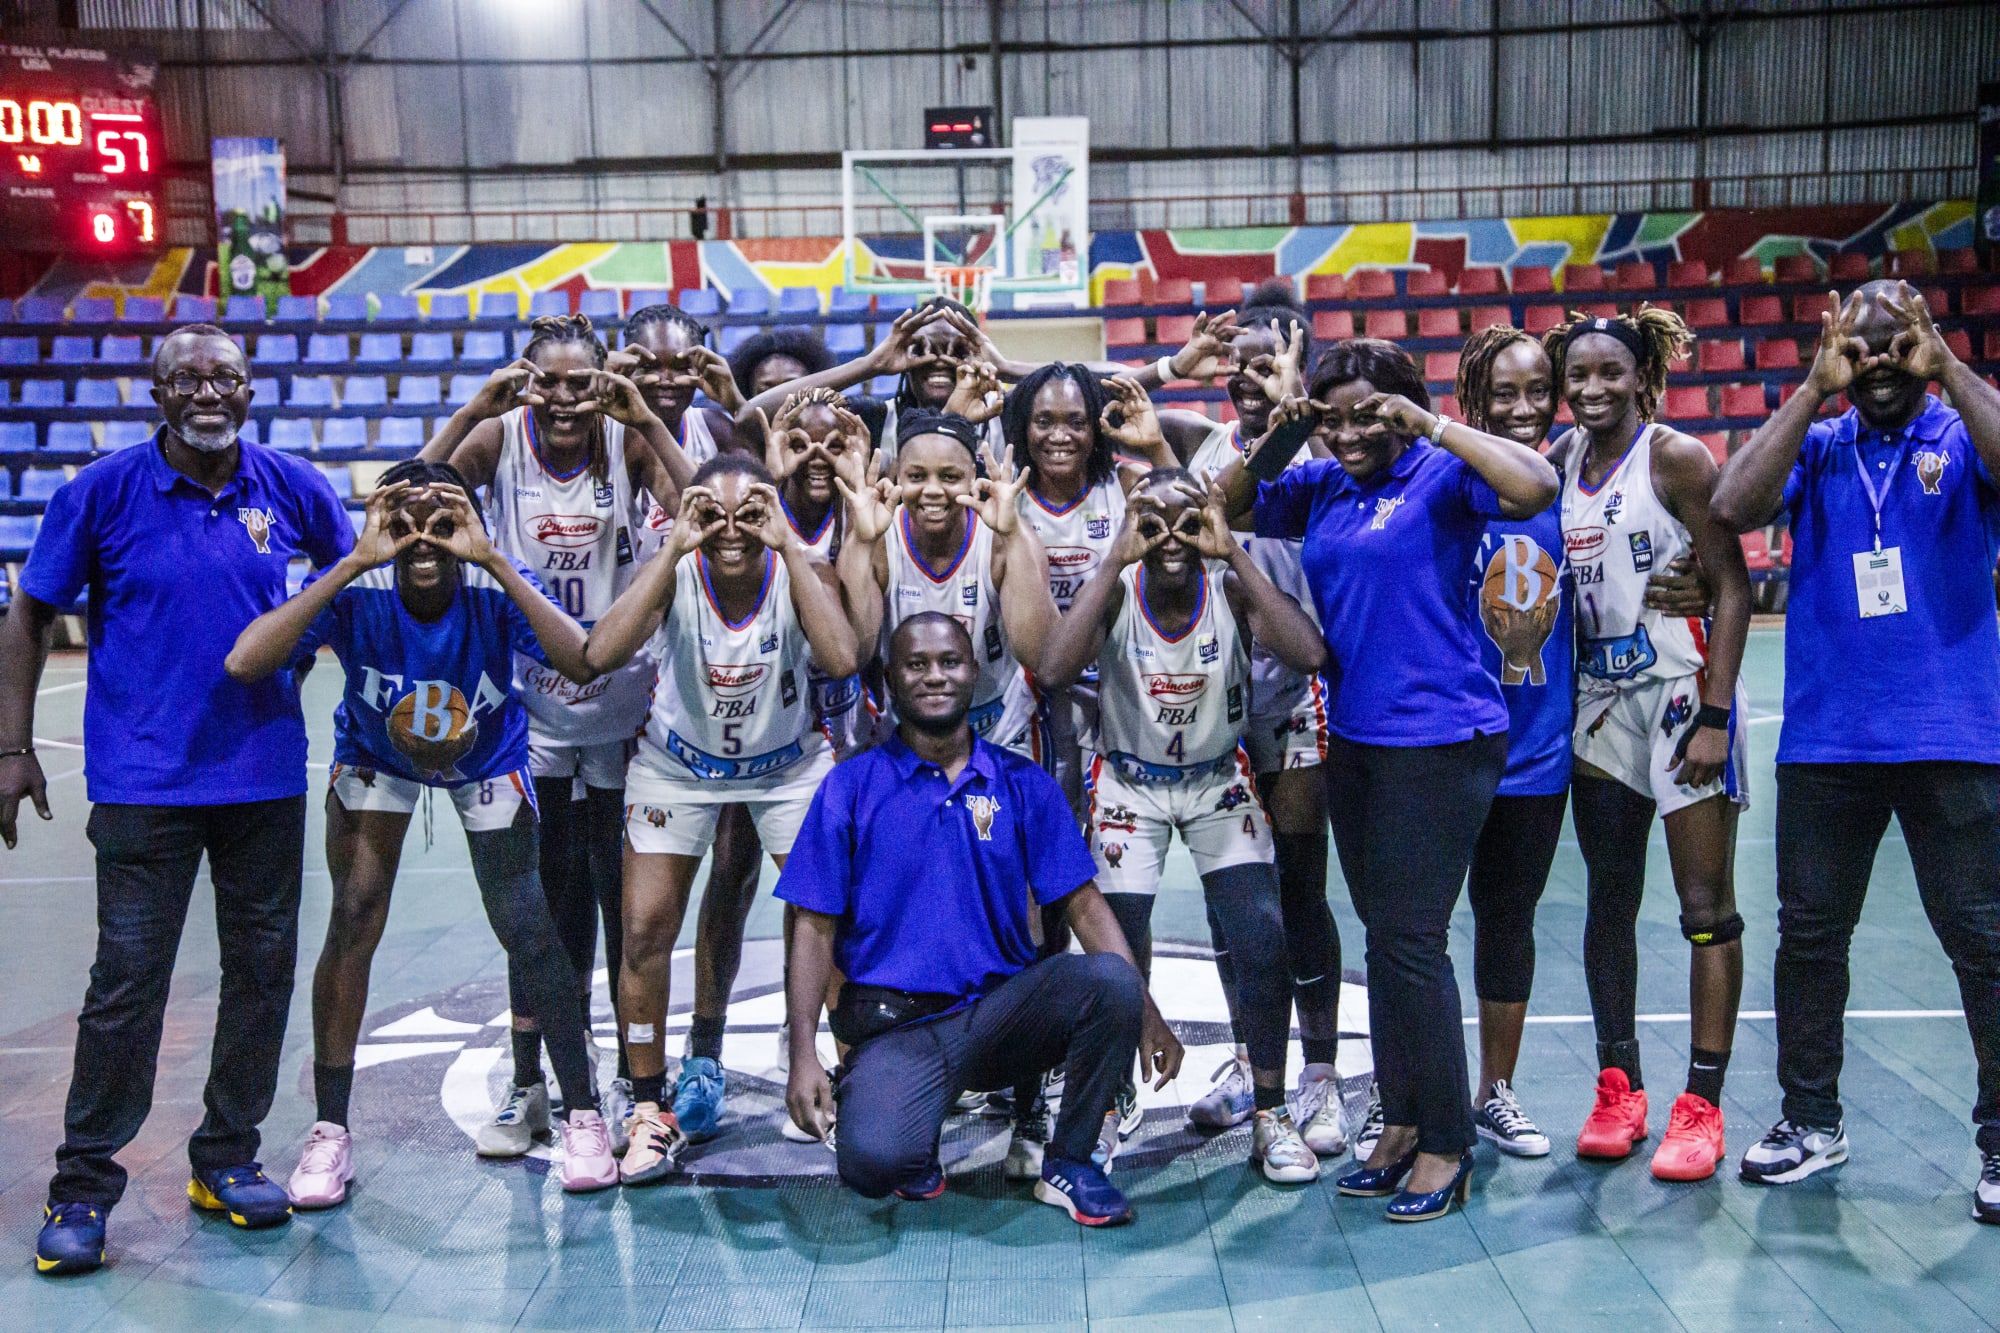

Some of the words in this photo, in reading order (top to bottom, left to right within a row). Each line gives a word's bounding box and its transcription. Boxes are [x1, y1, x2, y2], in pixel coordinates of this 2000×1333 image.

[21, 58, 52, 71] USA
[81, 96, 144, 113] GUEST
[97, 130, 149, 173] 57
[537, 517, 599, 537] Princesse
[543, 551, 591, 571] FBA
[1635, 553, 1651, 563] FIBA
[357, 666, 508, 742] FBA
[710, 696, 757, 719] FBA
[1153, 705, 1198, 725] FBA
[722, 723, 743, 757] 5
[1166, 730, 1186, 764] 4
[480, 780, 493, 806] 8
[1241, 814, 1257, 839] 4
